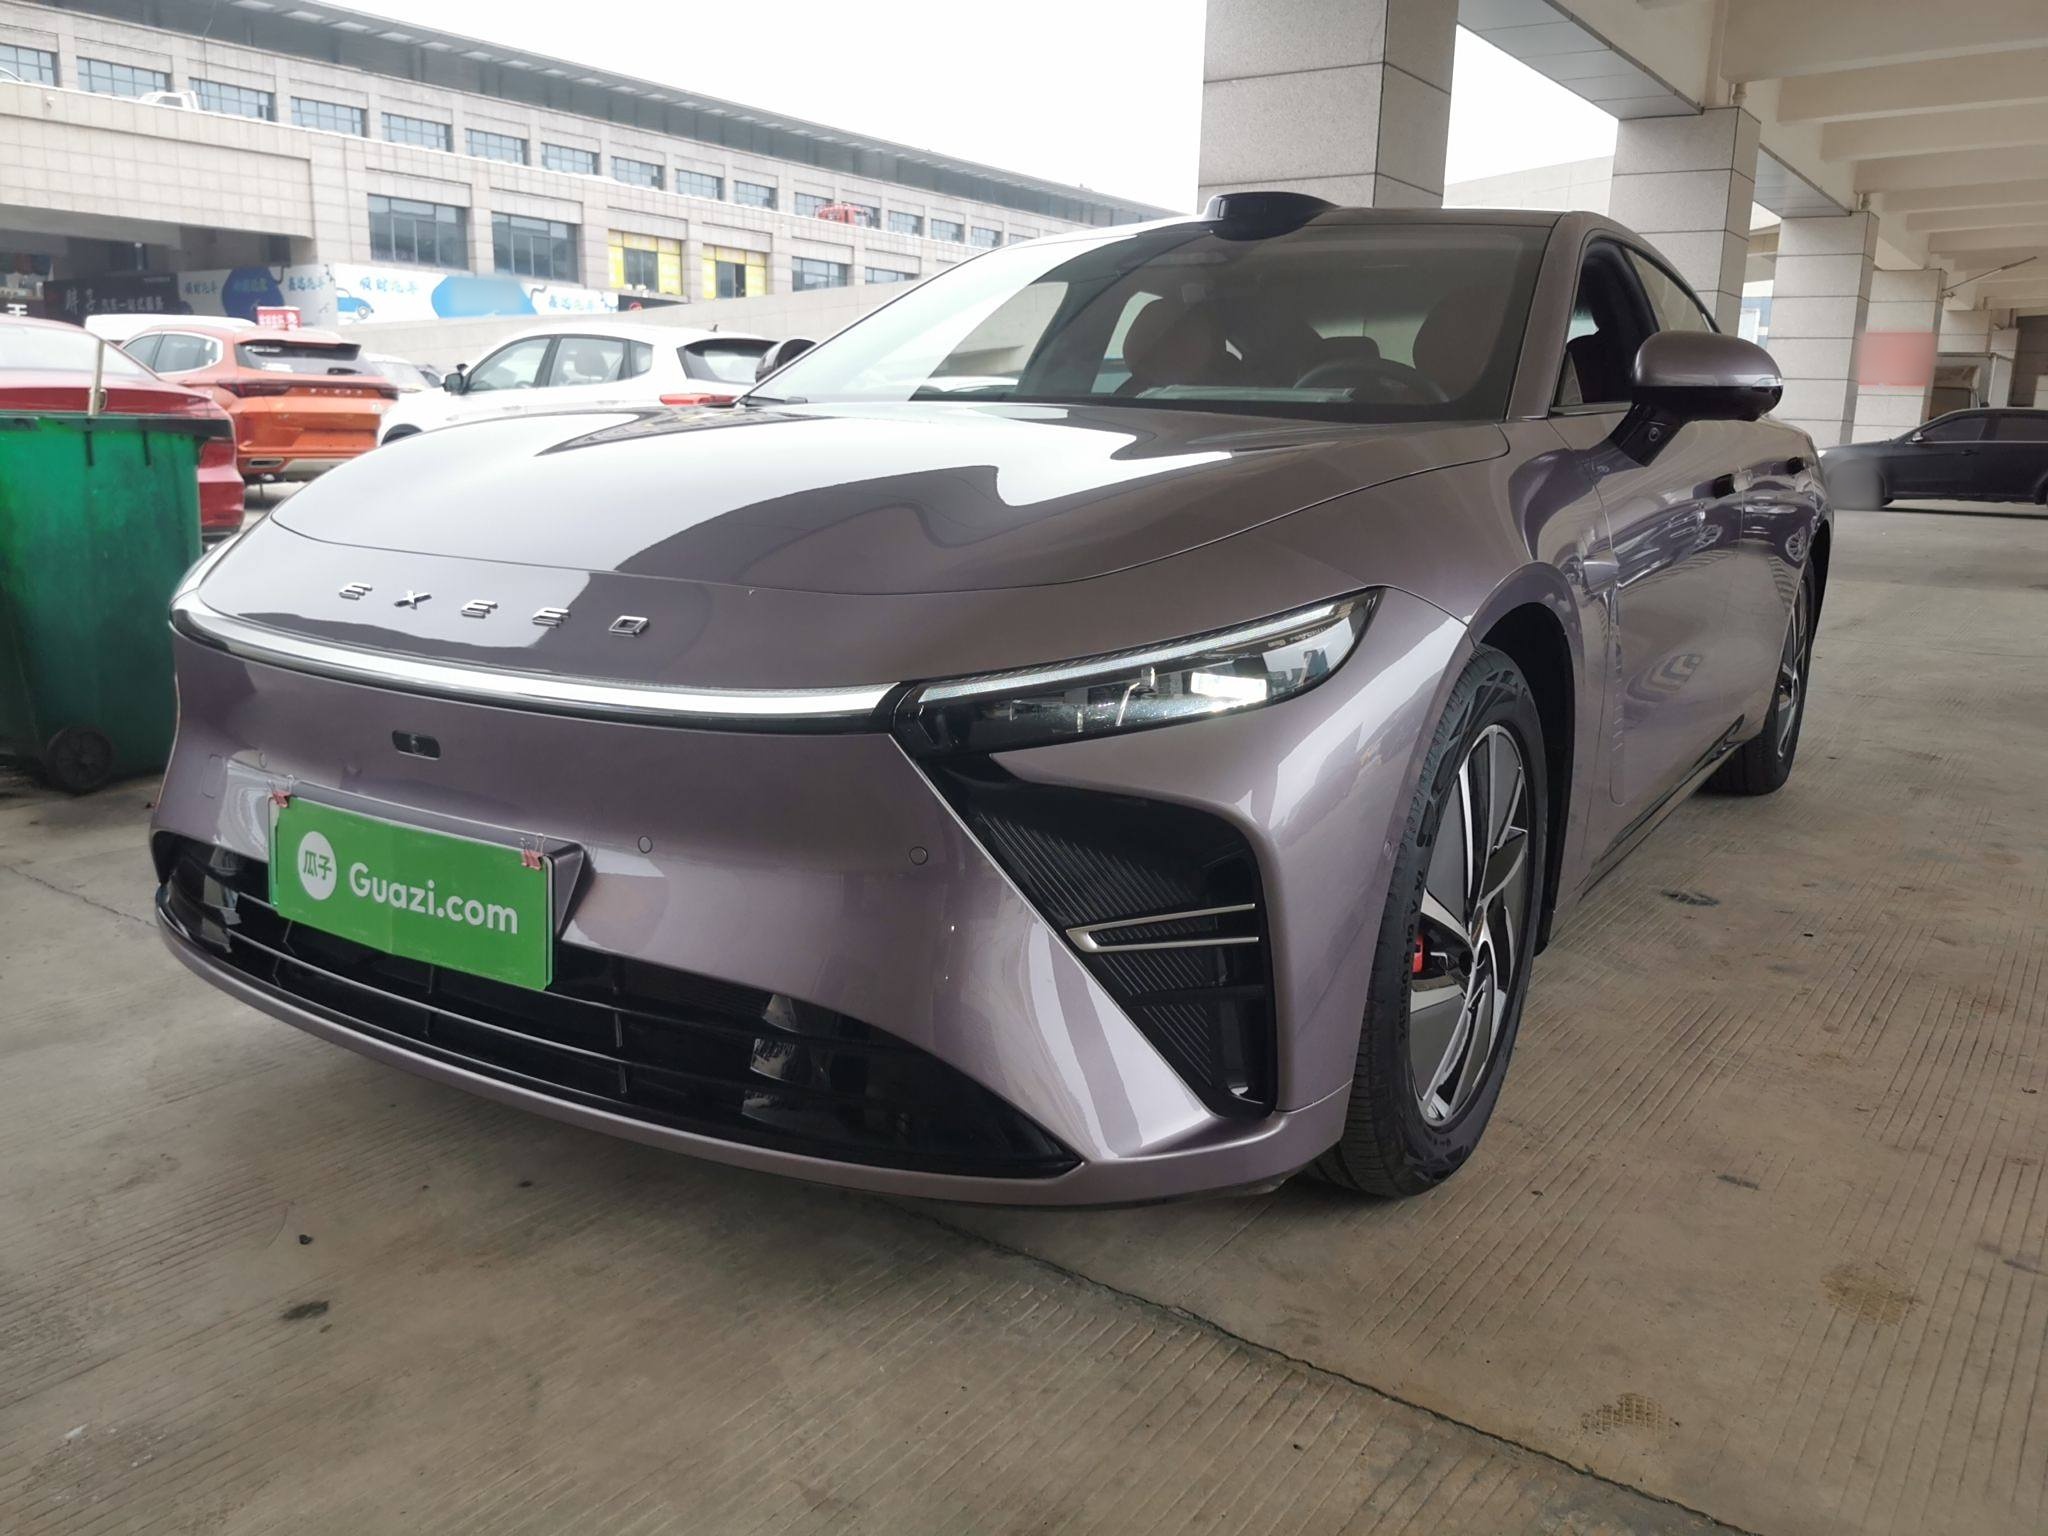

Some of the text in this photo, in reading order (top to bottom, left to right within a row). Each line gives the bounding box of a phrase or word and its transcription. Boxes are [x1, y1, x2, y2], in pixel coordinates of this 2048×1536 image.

[338, 582, 650, 637] EXEED
[303, 849, 333, 881] 瓜子
[349, 862, 518, 934] Guazi.com
